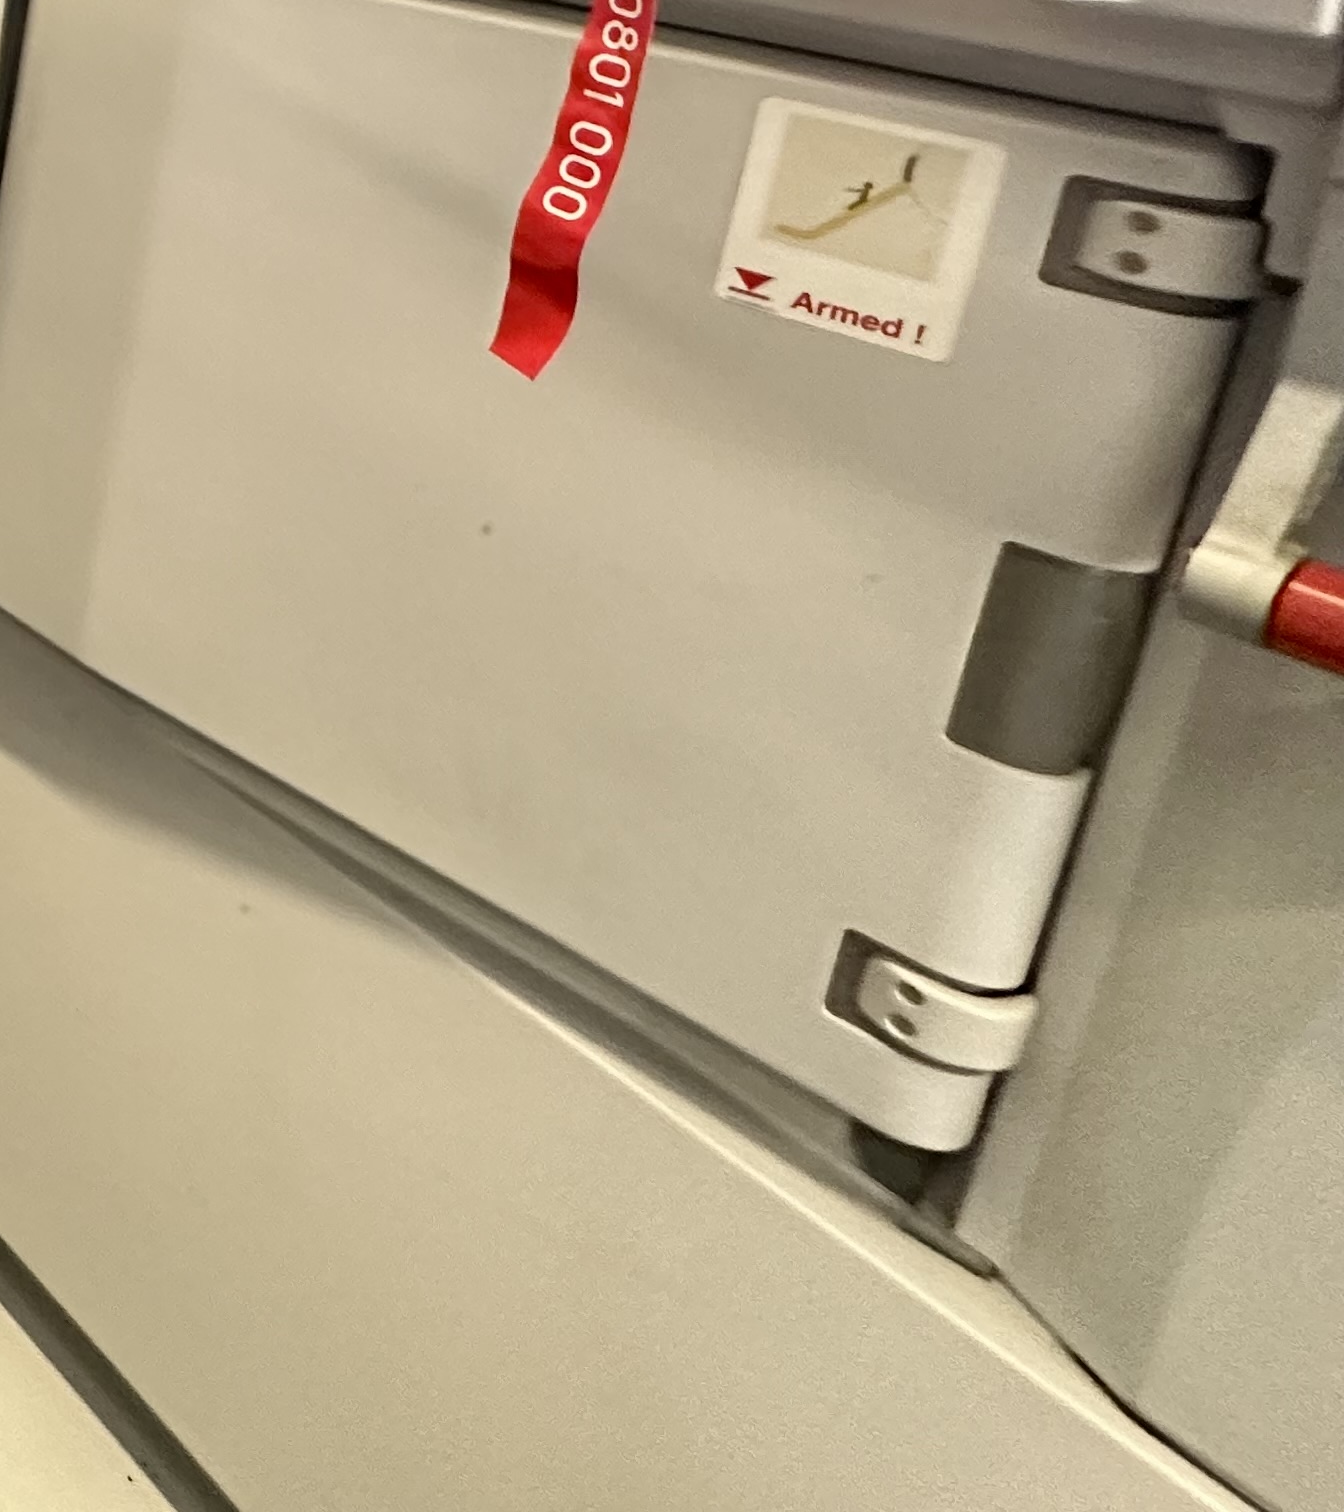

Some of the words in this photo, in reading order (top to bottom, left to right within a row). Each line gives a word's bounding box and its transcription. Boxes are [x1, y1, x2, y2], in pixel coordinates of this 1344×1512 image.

[542, 120, 613, 221] 000
[791, 292, 903, 339] Armed
[914, 324, 927, 345] !
